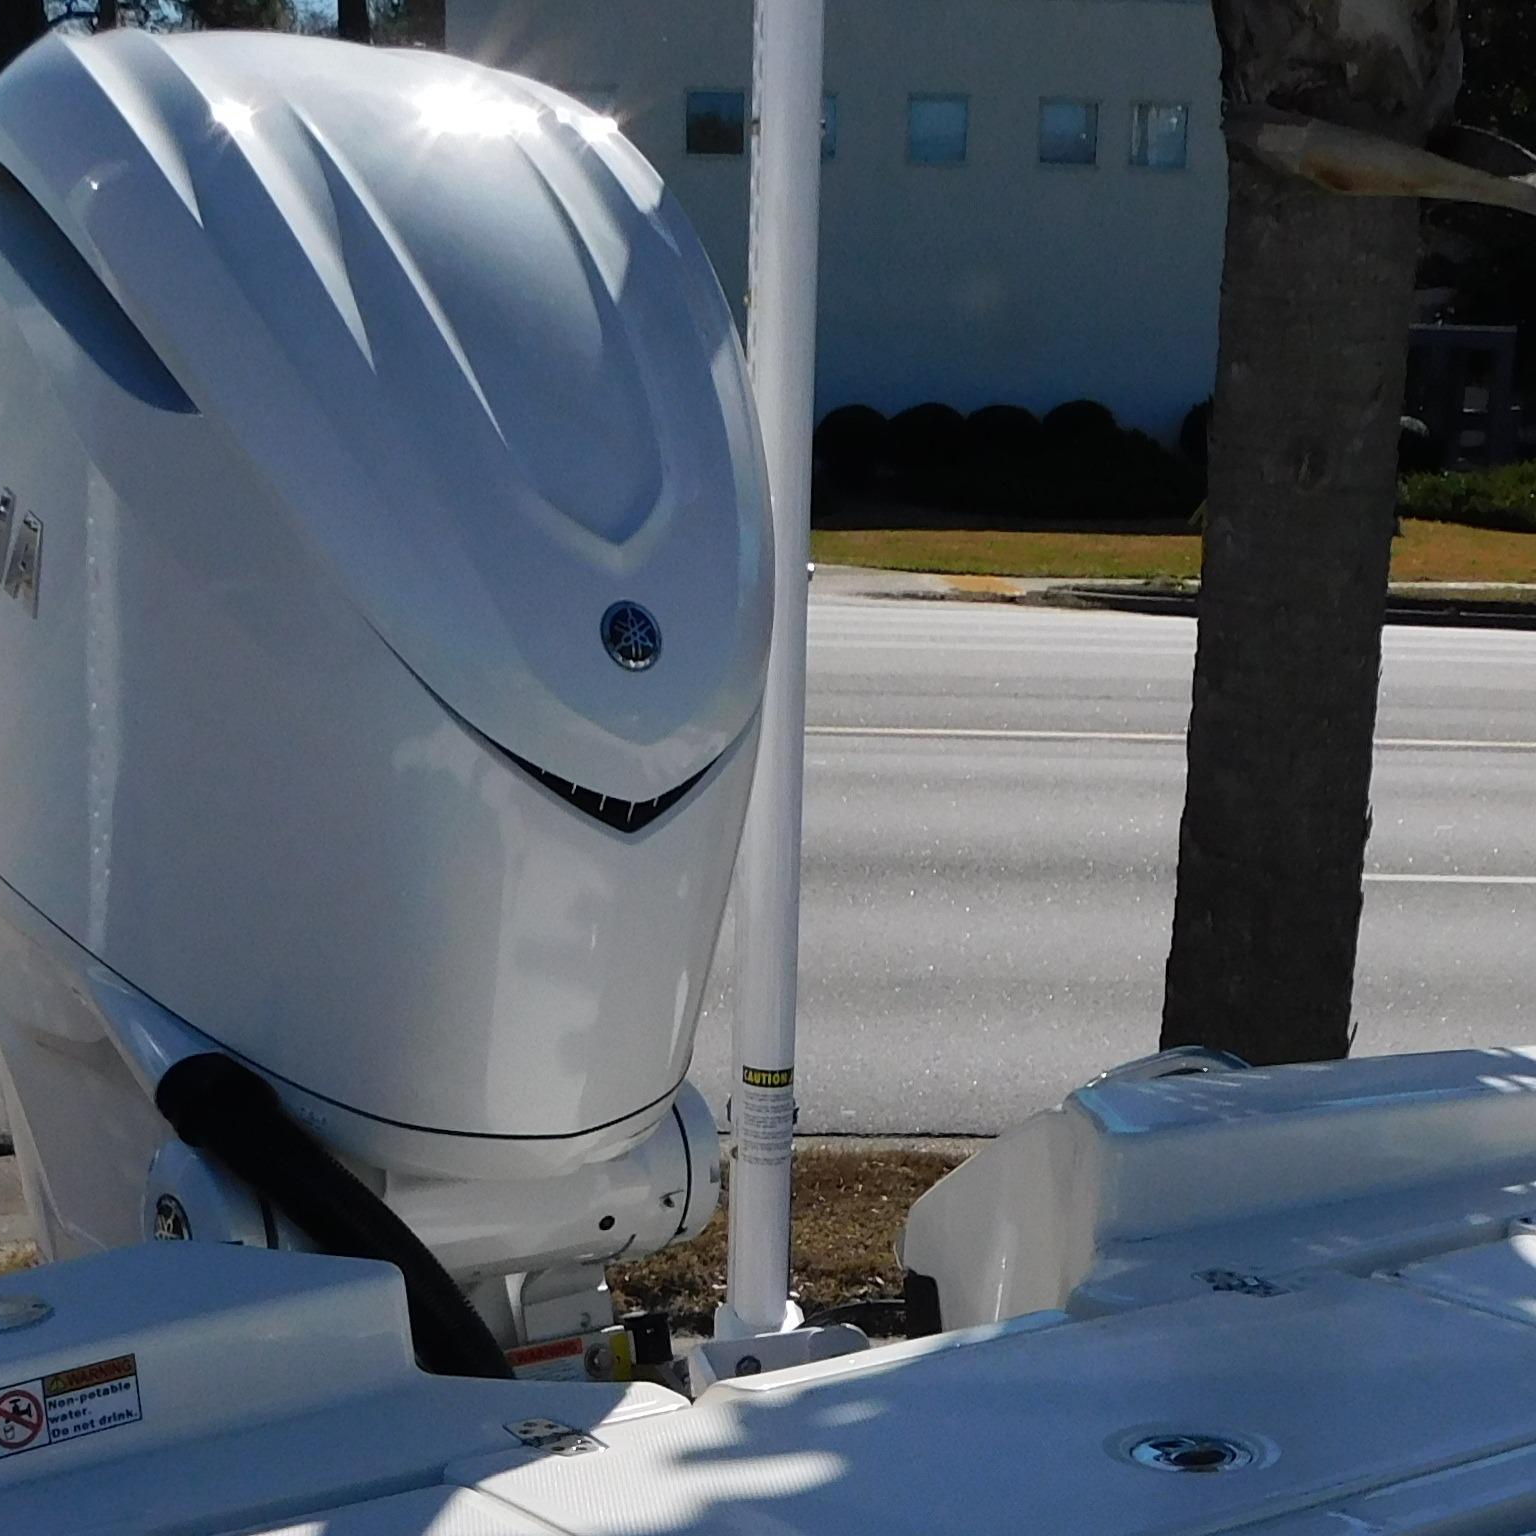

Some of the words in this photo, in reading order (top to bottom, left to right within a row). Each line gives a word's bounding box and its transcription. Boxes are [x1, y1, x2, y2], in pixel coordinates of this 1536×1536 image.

[744, 1068, 788, 1086] CAUTION
[64, 1358, 133, 1388] WARNING
[48, 1381, 131, 1411] Non-potable
[49, 1408, 92, 1424] water.
[52, 1427, 69, 1439] Do
[73, 1420, 95, 1433] not
[99, 1409, 138, 1425] drink.
